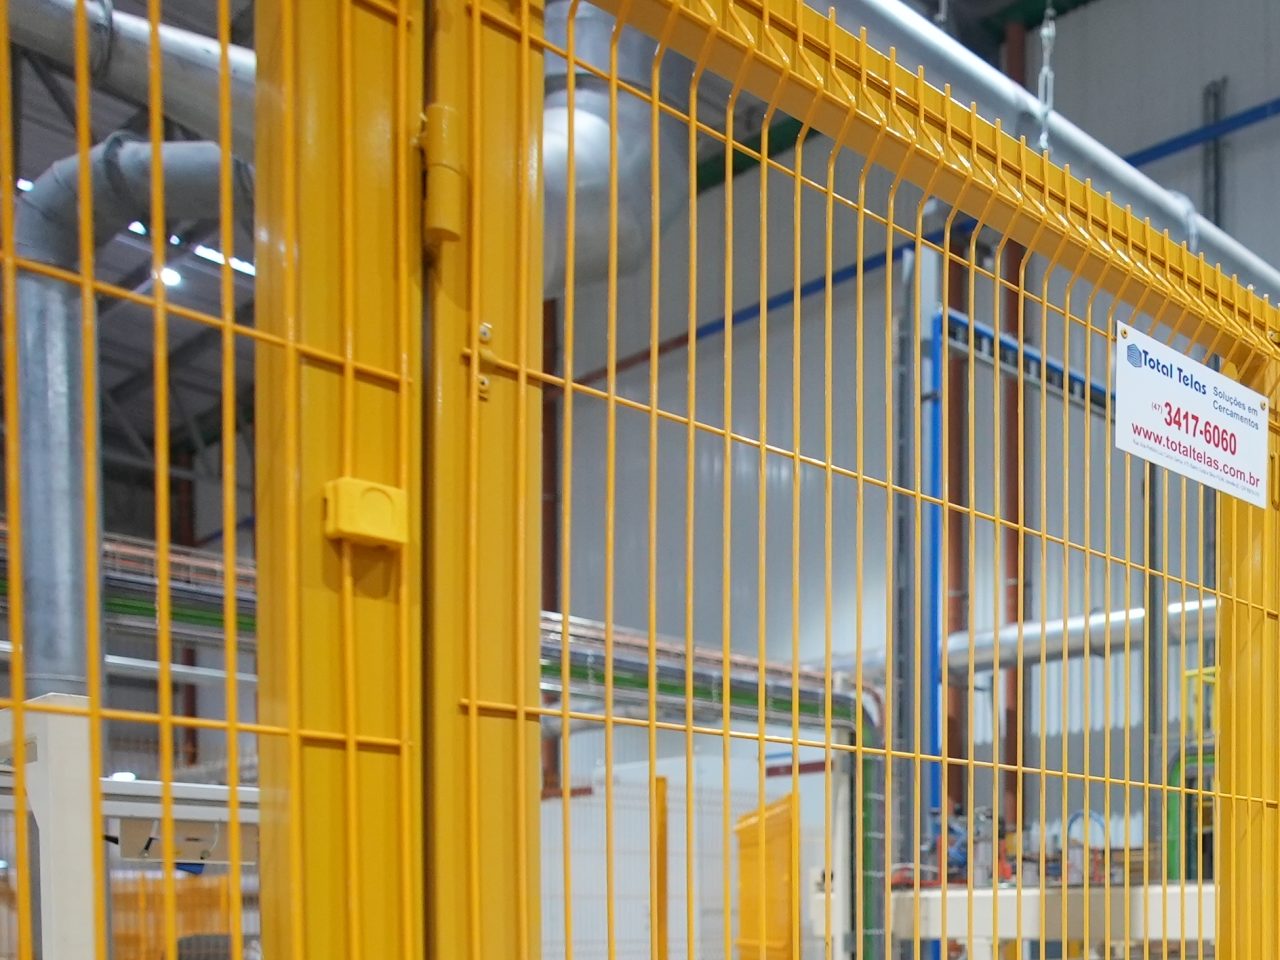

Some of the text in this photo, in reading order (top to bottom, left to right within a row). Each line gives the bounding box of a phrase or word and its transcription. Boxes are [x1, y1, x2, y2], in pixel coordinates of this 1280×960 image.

[1142, 349, 1207, 395] Total Telas
[1213, 386, 1258, 417] Soluções em
[1213, 400, 1259, 430] Cercamentos
[1164, 402, 1237, 456] 3417-6060
[1131, 422, 1260, 488] www.totaltelas.com.br
